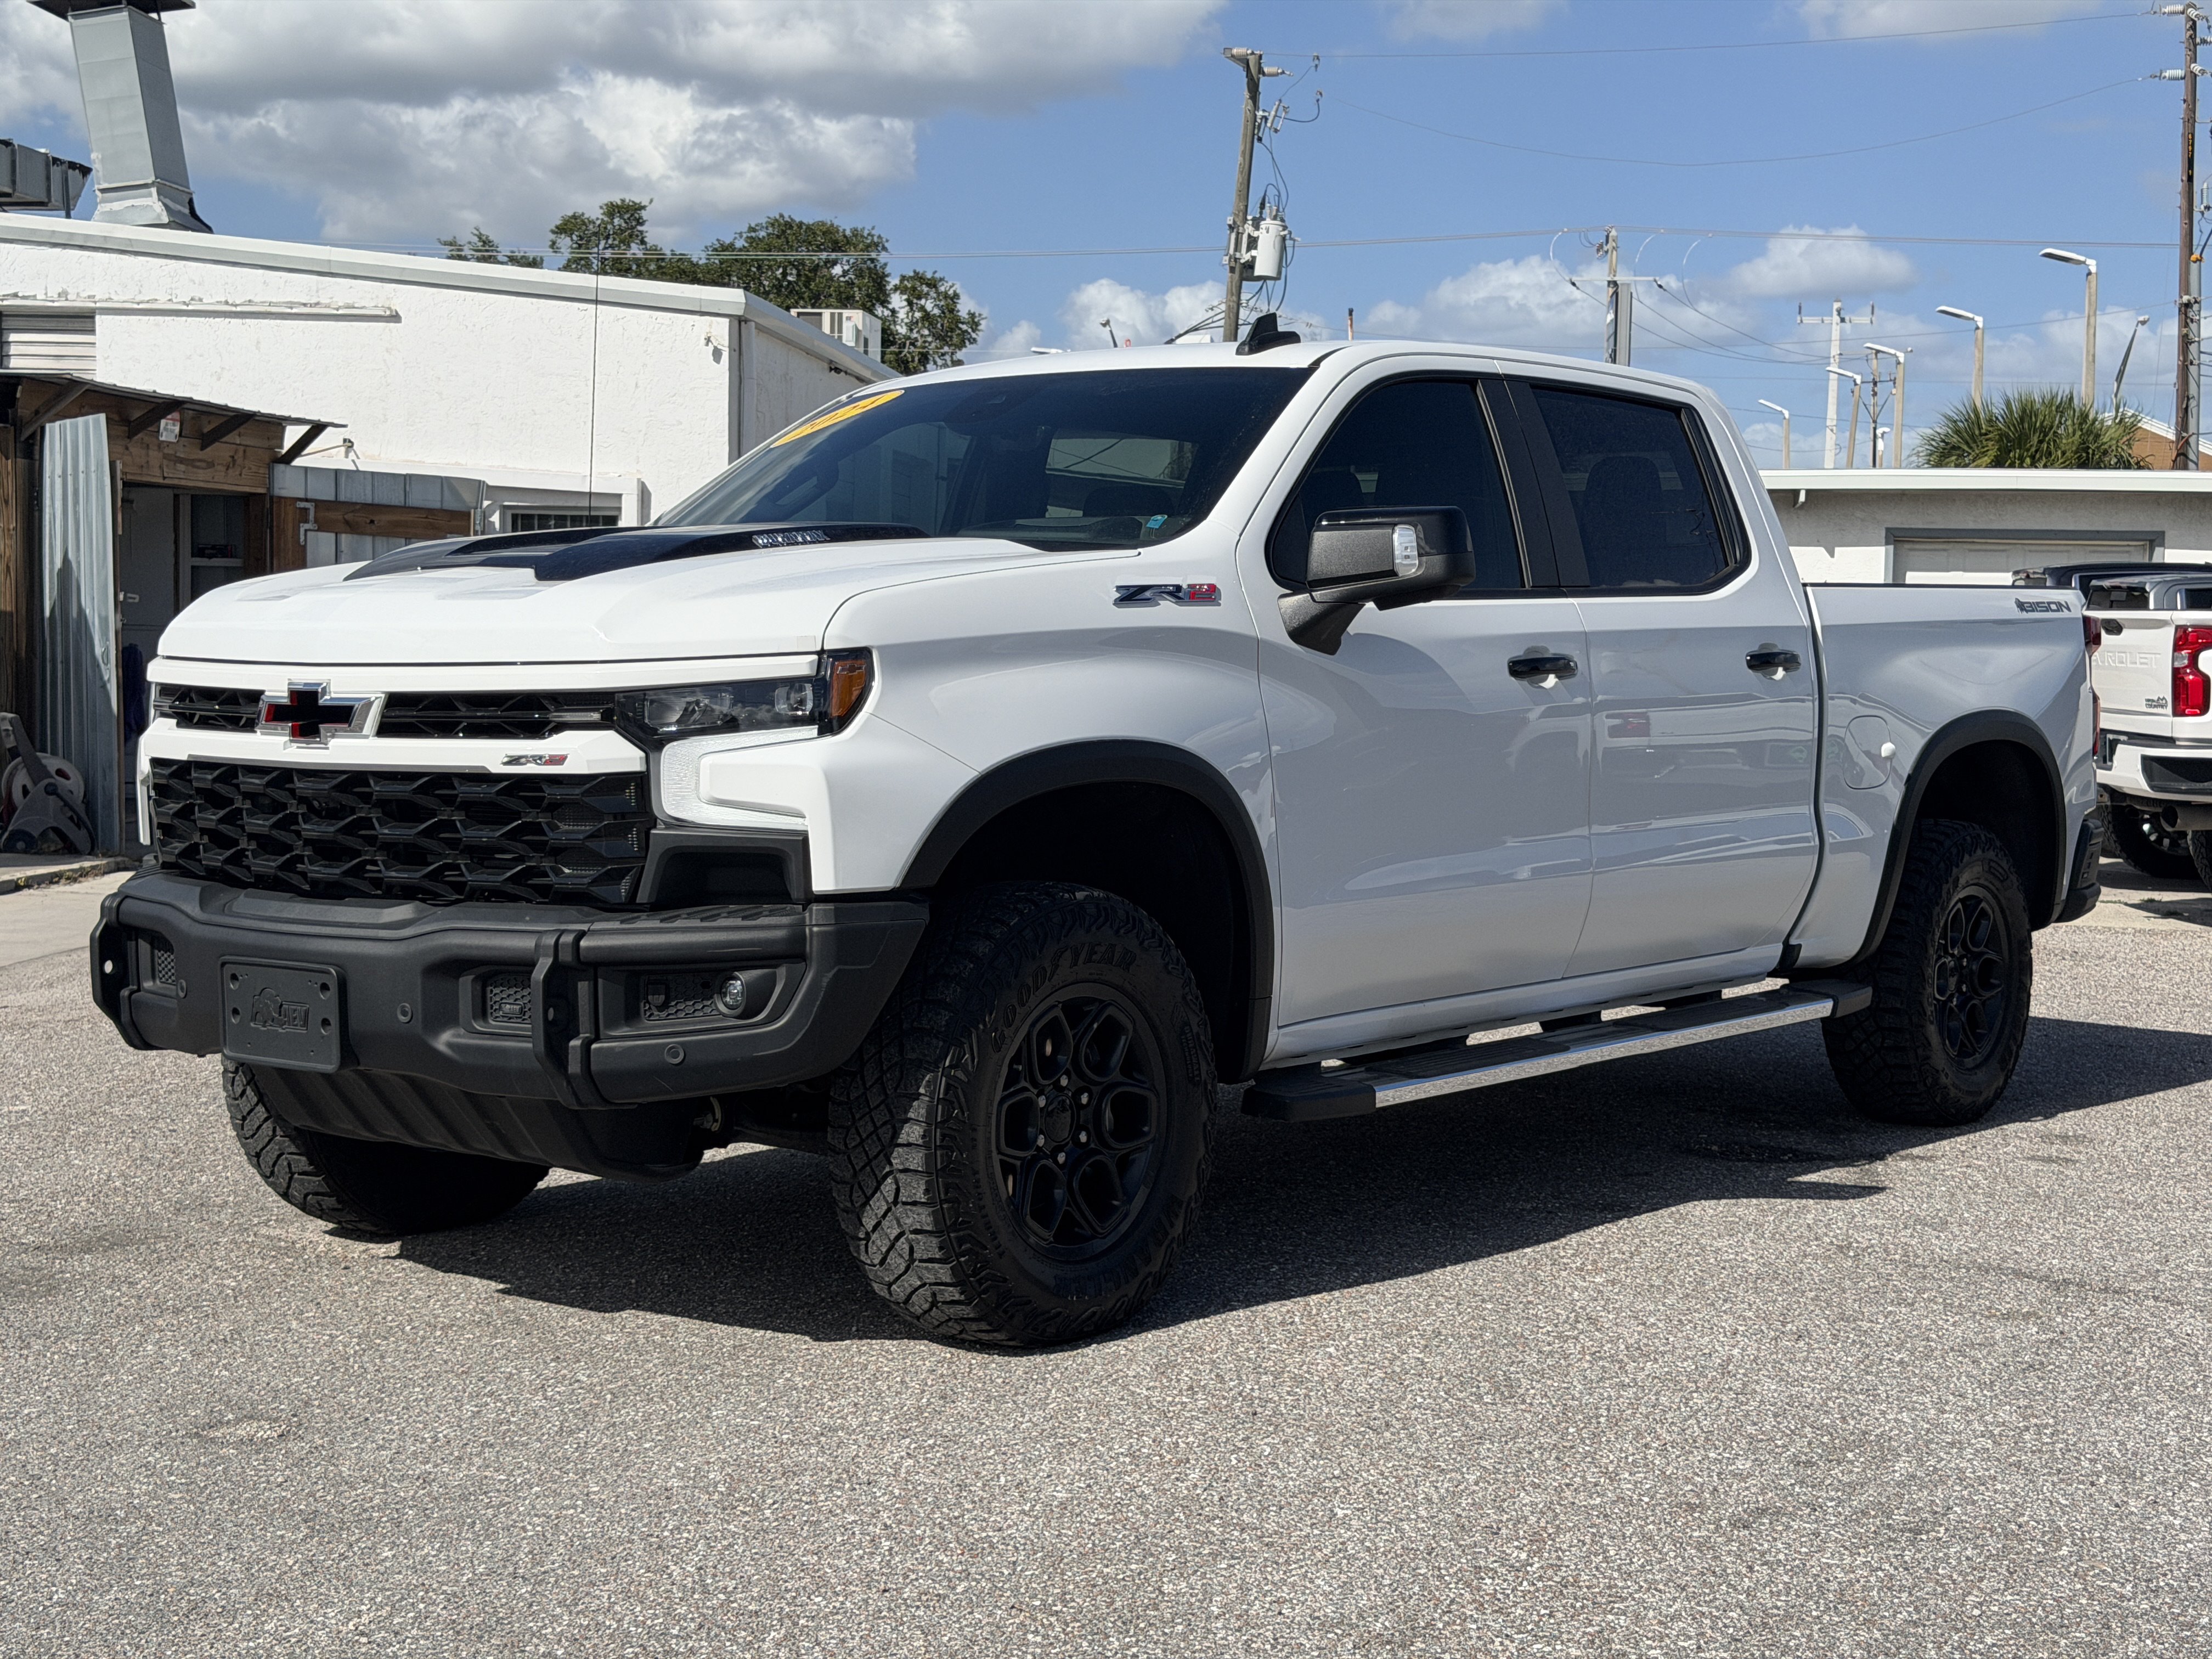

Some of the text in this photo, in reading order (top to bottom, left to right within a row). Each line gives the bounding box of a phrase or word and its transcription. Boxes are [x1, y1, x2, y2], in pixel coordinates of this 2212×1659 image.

[1113, 583, 1217, 604] ZR2
[2022, 601, 2072, 613] BISON
[992, 943, 1137, 1053] GOODYEAR
